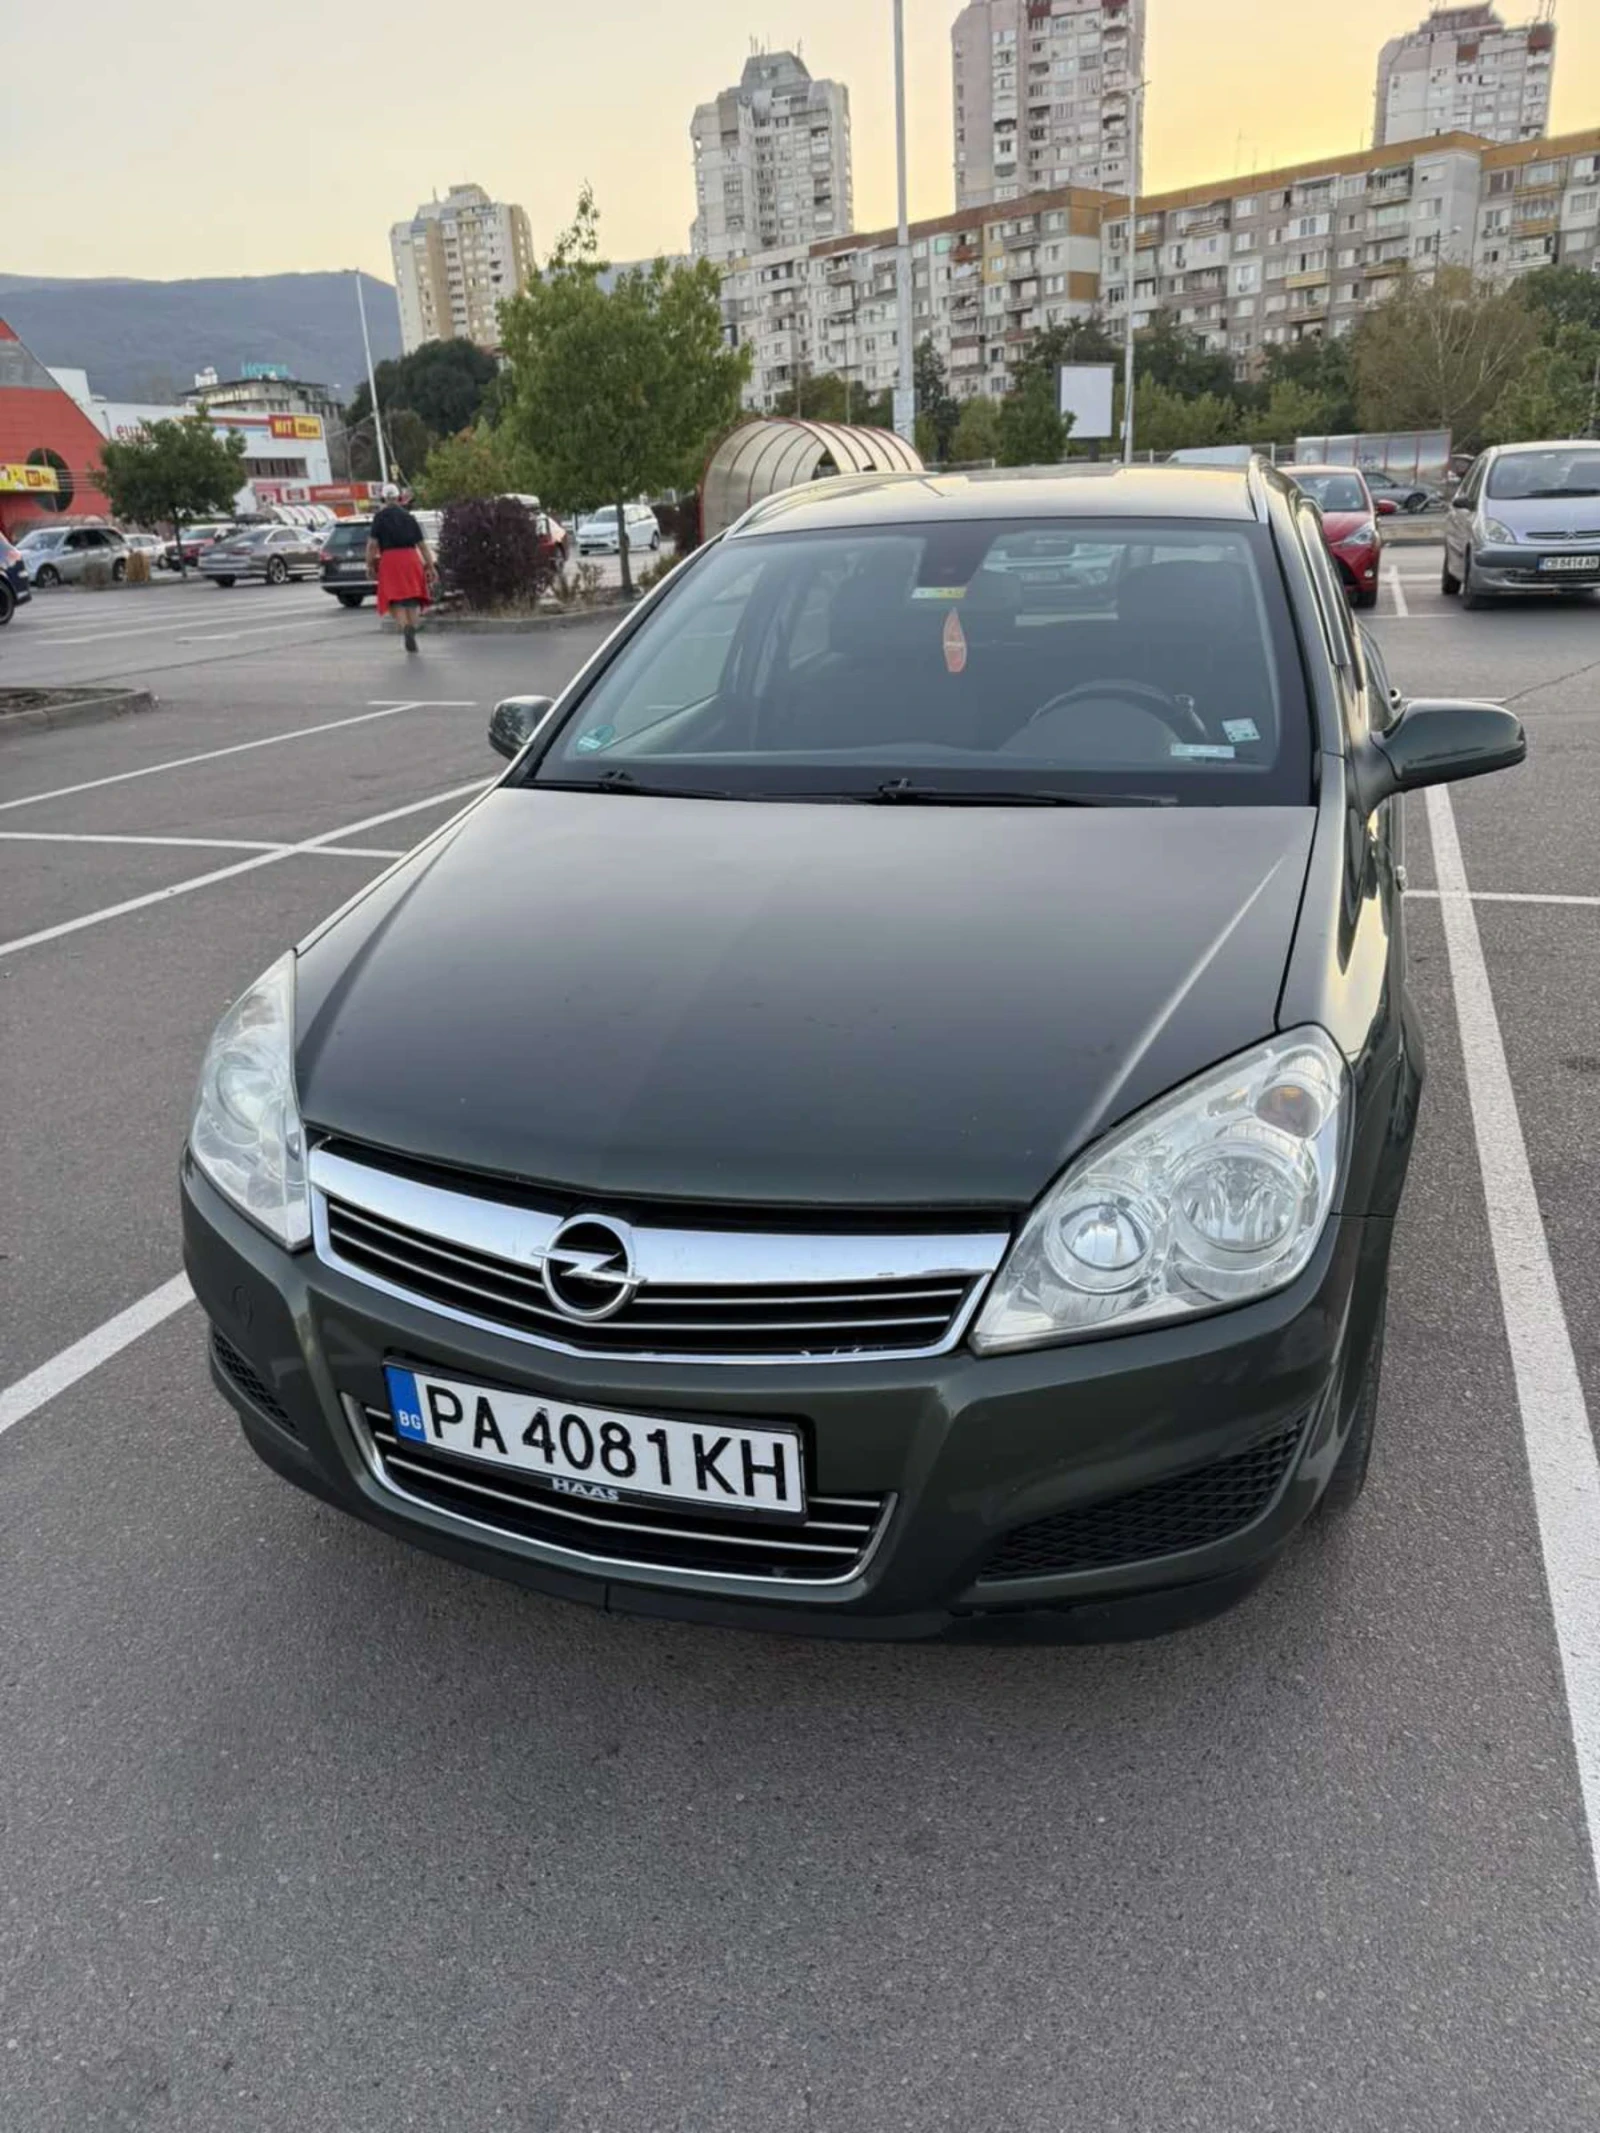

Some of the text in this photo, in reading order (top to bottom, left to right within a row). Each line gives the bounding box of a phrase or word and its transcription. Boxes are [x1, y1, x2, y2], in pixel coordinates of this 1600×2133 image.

[398, 1410, 422, 1430] BG
[426, 1384, 788, 1501] PA 4081 KH
[552, 1477, 620, 1502] HAAS
